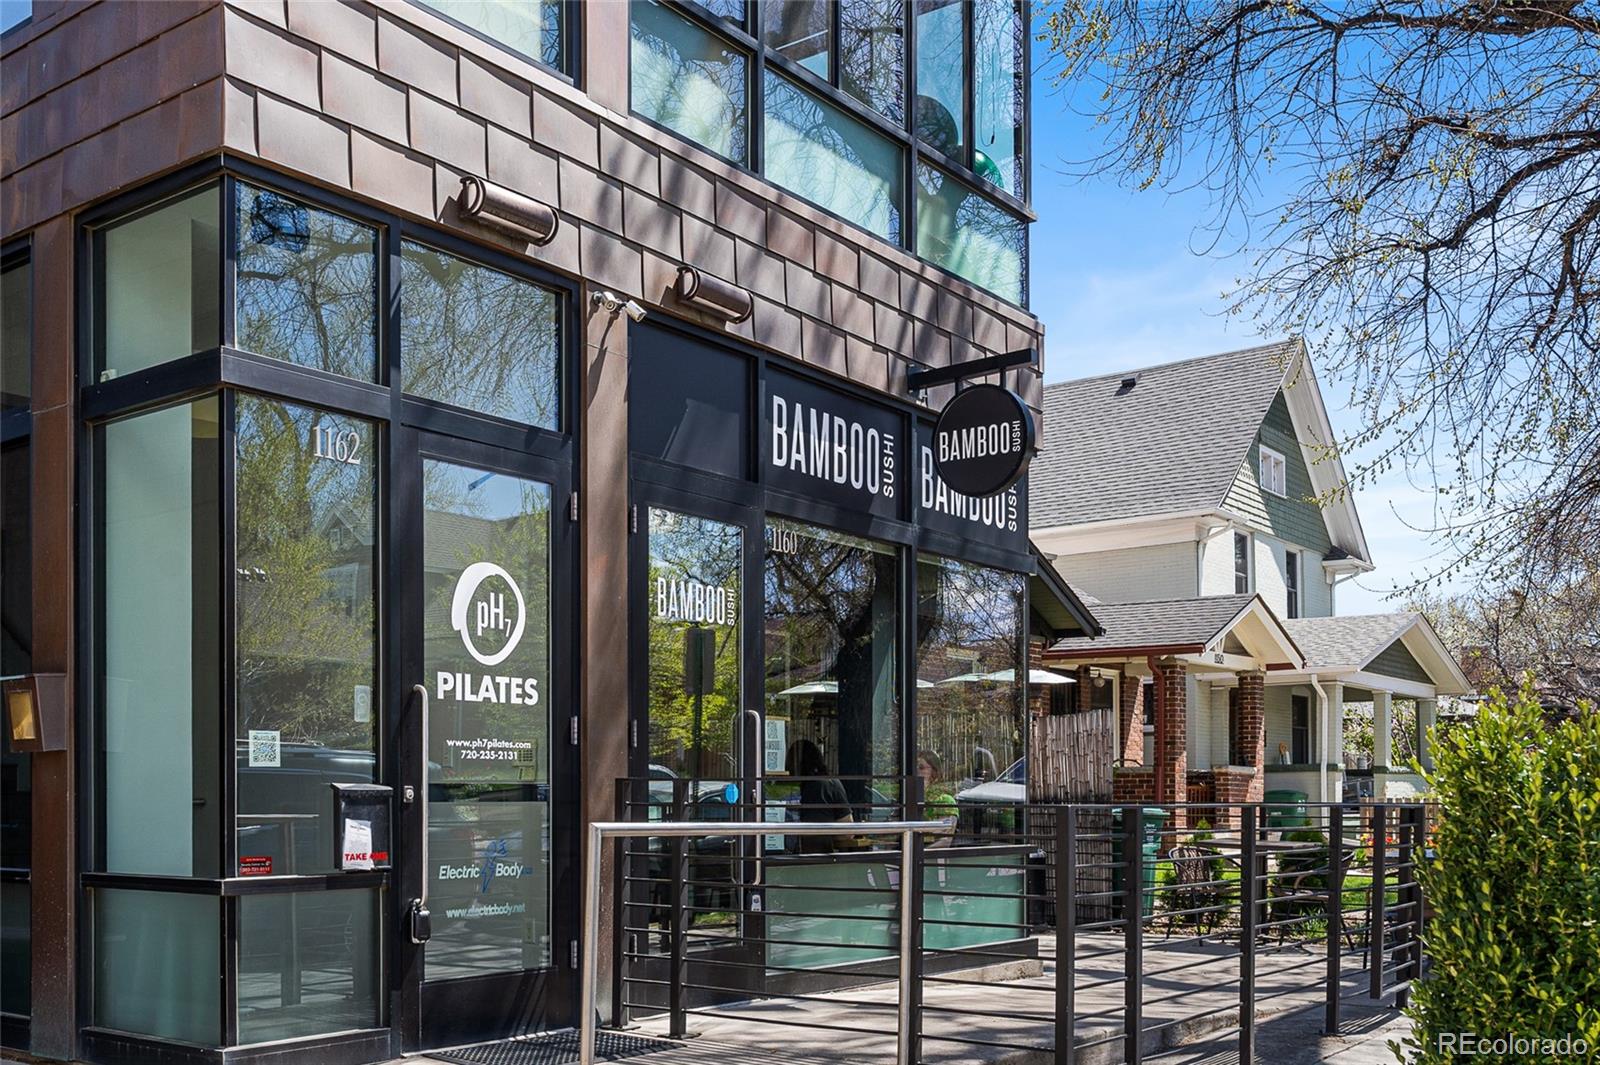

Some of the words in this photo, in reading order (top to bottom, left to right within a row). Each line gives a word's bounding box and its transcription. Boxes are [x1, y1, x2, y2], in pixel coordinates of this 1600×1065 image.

[312, 424, 362, 465] 1162
[772, 394, 880, 495] BAMBOO
[939, 422, 1011, 463] BAMBOO
[1012, 419, 1021, 453] SUSHI
[883, 432, 895, 499] SUSHI
[1007, 482, 1018, 533] SUSH
[771, 526, 798, 556] 1160
[657, 576, 726, 626] BAMBOO
[726, 588, 736, 627] SUSHI
[436, 671, 540, 707] PILATES
[446, 737, 532, 750] www.ph7pilates.com
[460, 749, 519, 761] 720-235-2131
[344, 852, 368, 862] TAKE
[438, 863, 480, 880] Electric
[495, 861, 524, 879] Body
[446, 901, 527, 919] www.electricbody.net
